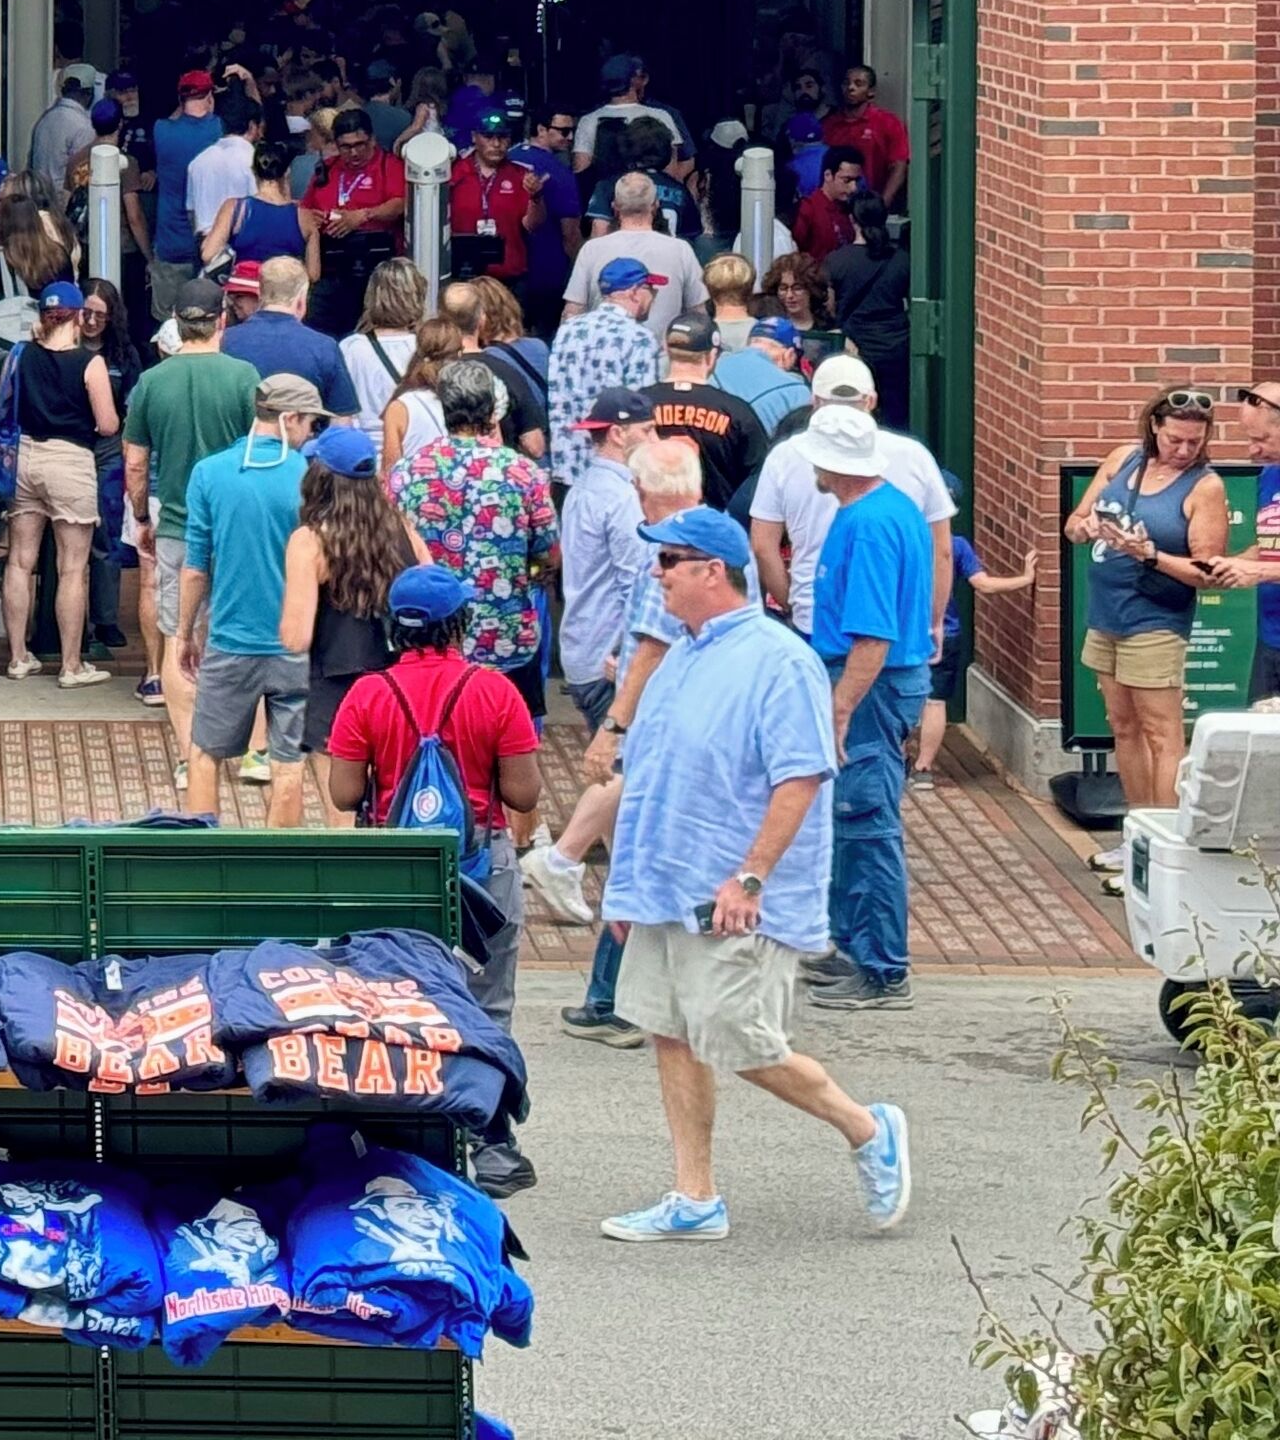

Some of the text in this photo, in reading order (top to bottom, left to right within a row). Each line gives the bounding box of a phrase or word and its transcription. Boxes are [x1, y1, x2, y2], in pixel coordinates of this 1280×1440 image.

[52, 1024, 226, 1085] BEAR
[267, 1032, 445, 1095] BEAR
[164, 1287, 246, 1325] Northside
